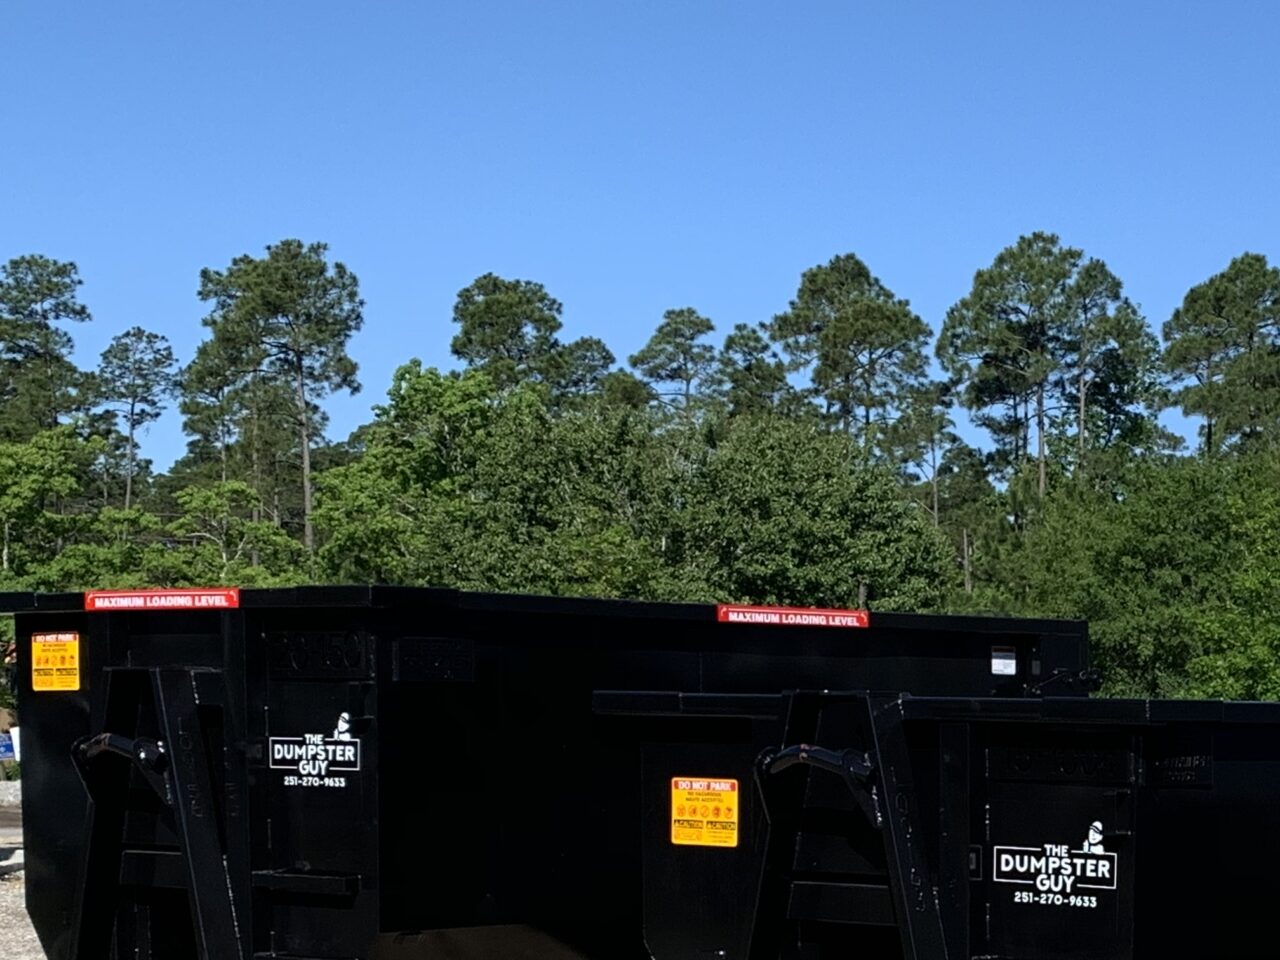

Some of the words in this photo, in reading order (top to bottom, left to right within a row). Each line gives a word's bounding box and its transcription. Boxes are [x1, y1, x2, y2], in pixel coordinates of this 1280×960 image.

[95, 597, 144, 608] MAXIMUM
[147, 596, 192, 607] LOADING
[194, 595, 228, 606] LEVEL
[728, 612, 780, 623] MAXIMUM
[782, 614, 827, 625] LOADING
[829, 616, 859, 626] LEVEL
[304, 734, 324, 744] THE
[273, 744, 355, 761] DUMPSTER
[298, 760, 328, 775] GUY
[284, 776, 346, 787] 251-270-9633
[1043, 844, 1069, 857] THE
[1000, 854, 1110, 878] DUMPSTER
[1036, 874, 1075, 893] GUY
[1014, 891, 1097, 908] 251-270-9633
